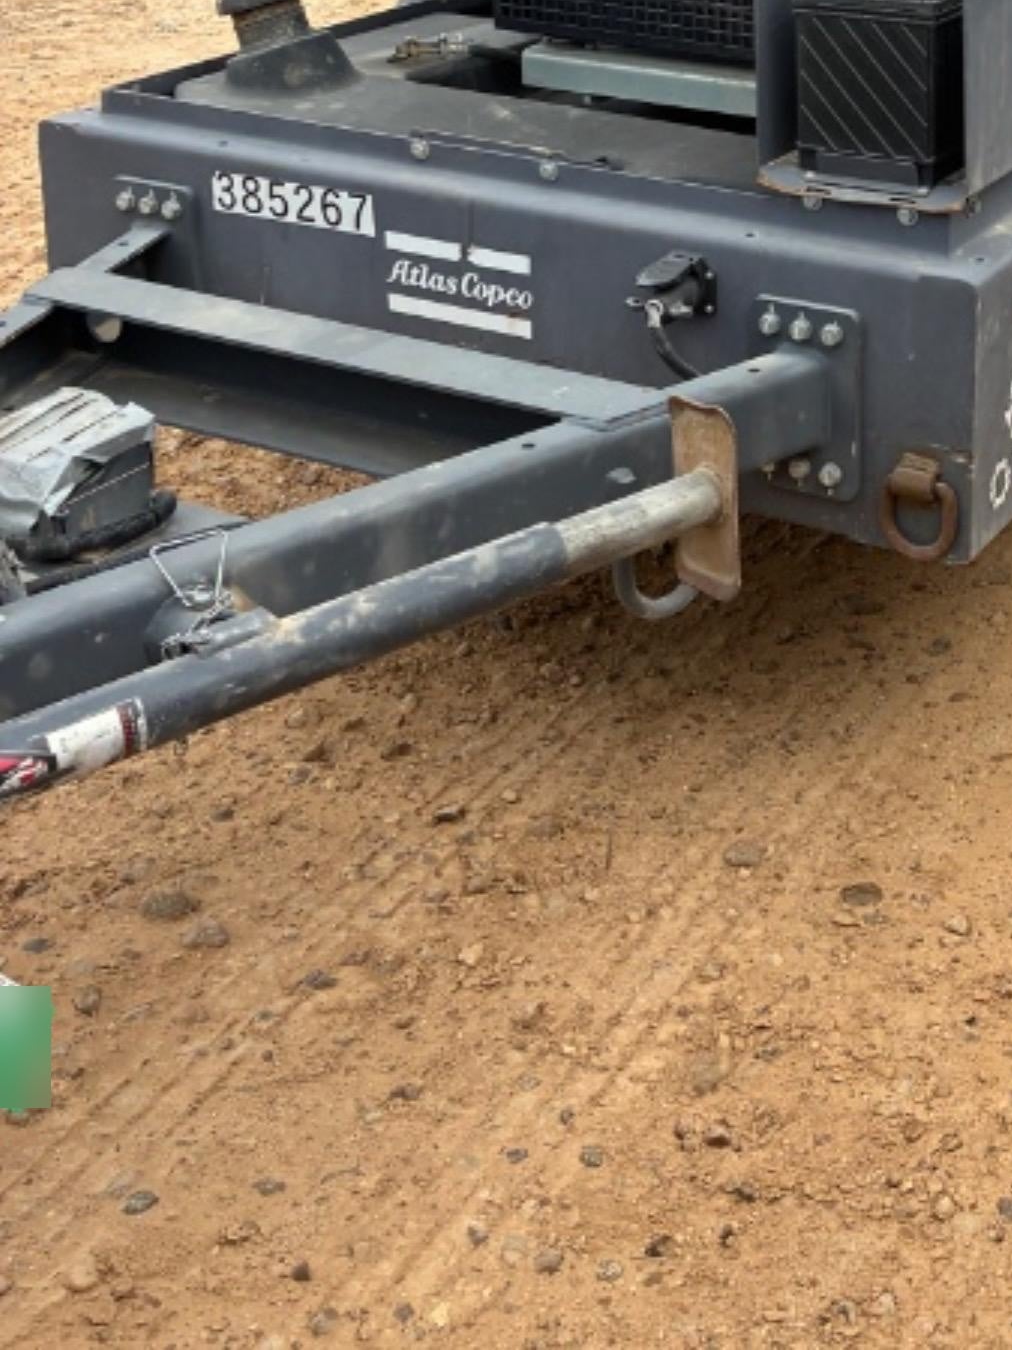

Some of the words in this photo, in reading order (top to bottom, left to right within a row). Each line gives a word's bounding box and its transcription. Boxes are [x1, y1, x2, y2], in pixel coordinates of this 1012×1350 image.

[217, 173, 367, 231] 385267
[386, 259, 459, 295] Atlas
[461, 272, 534, 310] Copco
